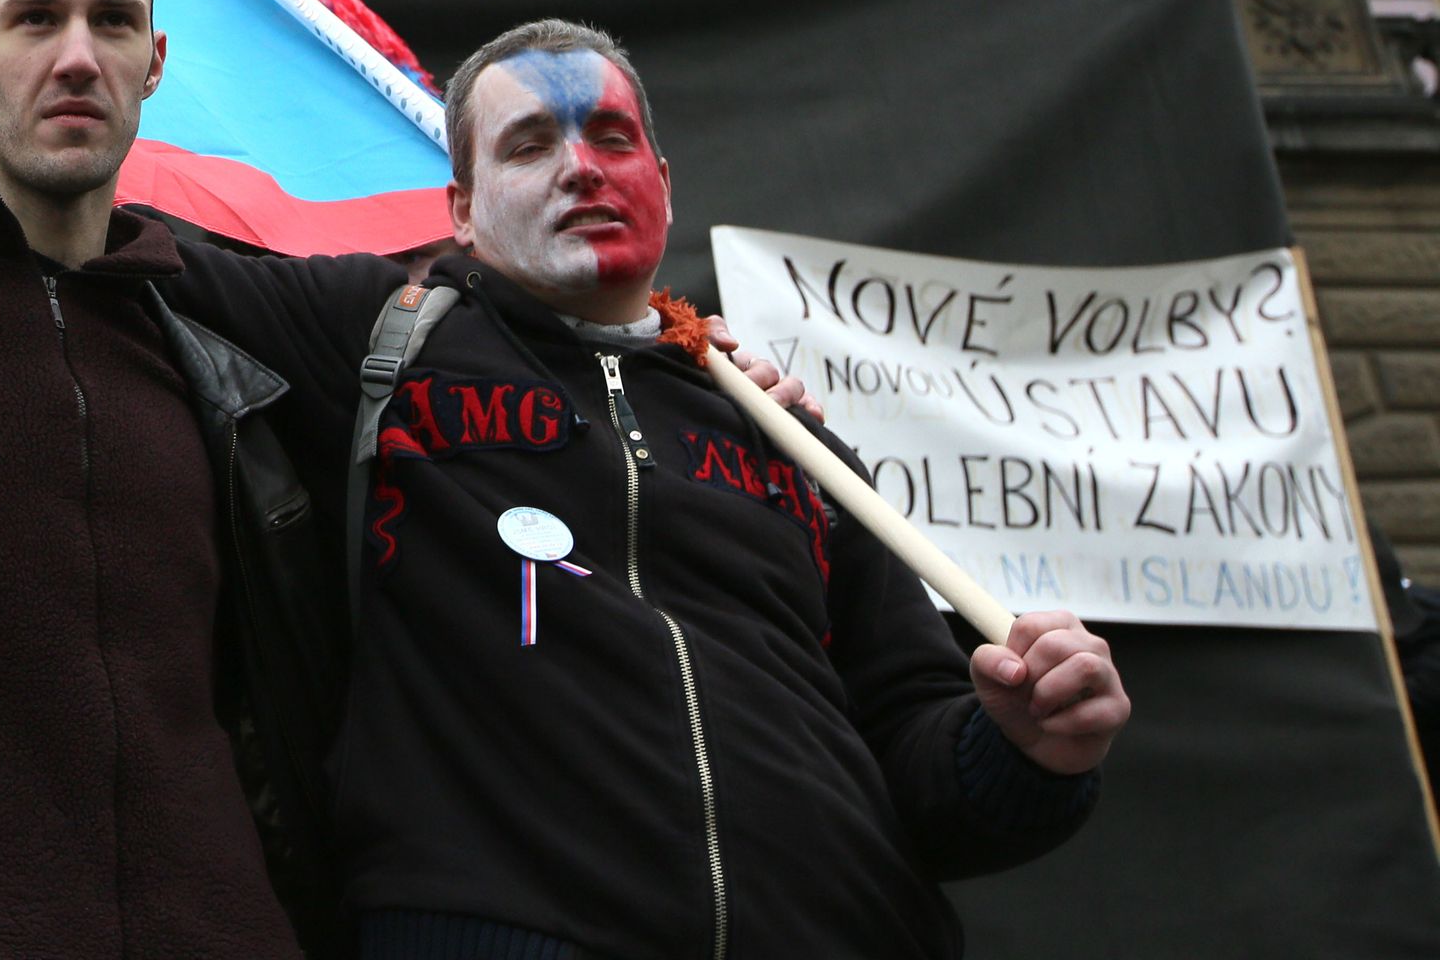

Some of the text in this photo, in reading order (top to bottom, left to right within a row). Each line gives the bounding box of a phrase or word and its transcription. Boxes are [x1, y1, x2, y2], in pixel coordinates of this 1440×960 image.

[783, 256, 1295, 357] NOVÉ VOLBY?
[824, 355, 954, 397] NOVOU
[956, 360, 1299, 441] ÚSTAVU
[853, 446, 1354, 544] OLEBNÍ ZÁKONY
[1000, 553, 1062, 600] NA
